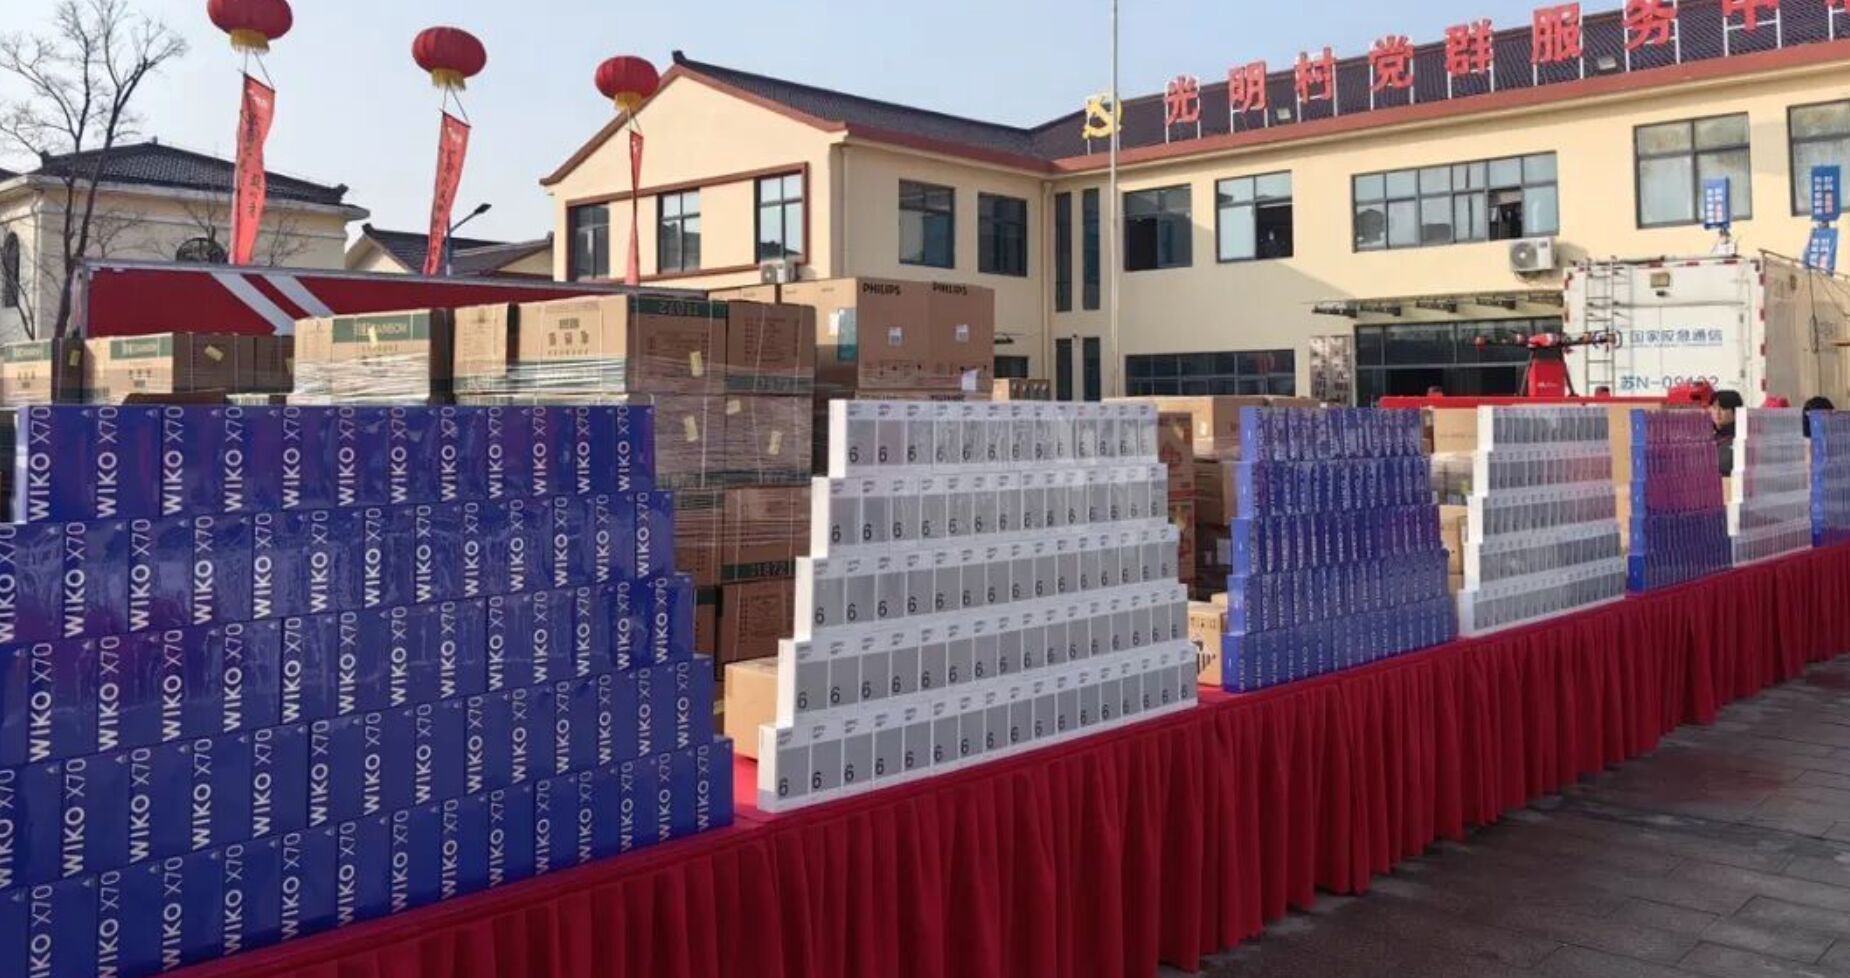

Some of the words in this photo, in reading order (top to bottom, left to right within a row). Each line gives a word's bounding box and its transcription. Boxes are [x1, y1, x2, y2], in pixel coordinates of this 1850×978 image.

[1165, 0, 1850, 124] 光明村党群服务中
[863, 283, 900, 295] PHILIPS
[933, 282, 967, 296] PHILIPS
[1630, 328, 1723, 342] 国家应急通信
[30, 407, 51, 444] X70
[98, 407, 118, 443] X70
[164, 407, 184, 442] X70
[226, 407, 244, 442] X70
[284, 407, 301, 442] X70
[339, 407, 356, 440] X70
[392, 407, 407, 439] X70
[442, 407, 456, 437] X70
[490, 407, 503, 438] X70
[534, 407, 547, 436] X70
[534, 443, 546, 496] WIKO
[849, 446, 859, 463] 6
[879, 446, 887, 463] 6
[908, 445, 916, 462] 6
[30, 453, 50, 521] WIKO
[97, 452, 117, 518] WIKO
[163, 450, 183, 515] WIKO
[225, 450, 243, 512] WIKO
[283, 448, 300, 509] WIKO
[338, 447, 355, 506] WIKO
[391, 446, 406, 504] WIKO
[442, 445, 456, 501] WIKO
[490, 445, 502, 499] WIKO
[312, 510, 328, 544] X70
[366, 508, 382, 541] X70
[416, 506, 432, 536] X70
[466, 503, 480, 533] X70
[511, 500, 525, 530] X70
[556, 497, 569, 526] X70
[922, 520, 930, 537] 6
[949, 518, 957, 534] 6
[975, 516, 983, 532] 6
[65, 522, 86, 560] X70
[131, 520, 151, 556] X70
[194, 517, 214, 553] X70
[254, 514, 272, 549] X70
[832, 525, 841, 543] 6
[864, 523, 871, 540] 6
[893, 522, 902, 538] 6
[365, 548, 380, 607] WIKO
[416, 544, 431, 602] WIKO
[466, 540, 478, 596] WIKO
[510, 538, 524, 592] WIKO
[555, 534, 568, 586] WIKO
[130, 564, 150, 631] WIKO
[194, 560, 213, 624] WIKO
[253, 556, 271, 618] WIKO
[311, 552, 328, 612] WIKO
[963, 590, 971, 606] 6
[988, 587, 995, 603] 6
[1012, 583, 1020, 599] 6
[1035, 580, 1043, 597] 6
[64, 569, 85, 637] WIKO
[442, 602, 456, 635] X70
[490, 596, 504, 630] X70
[534, 592, 548, 624] X70
[578, 587, 591, 619] X70
[815, 607, 824, 624] 6
[847, 603, 857, 621] 6
[878, 601, 887, 617] 6
[908, 596, 916, 612] 6
[936, 593, 944, 610] 6
[284, 618, 302, 655] X70
[340, 612, 357, 648] X70
[392, 606, 408, 641] X70
[100, 636, 120, 676] X70
[163, 630, 183, 669] X70
[224, 624, 244, 661] X70
[534, 629, 548, 684] WIKO
[577, 623, 590, 676] WIKO
[1024, 652, 1031, 668] 6
[1047, 648, 1055, 663] 6
[1069, 644, 1076, 659] 6
[30, 644, 52, 684] X70
[392, 648, 406, 706] WIKO
[442, 641, 456, 698] WIKO
[490, 635, 503, 691] WIKO
[922, 671, 931, 688] 6
[949, 666, 957, 683] 6
[975, 661, 984, 677] 6
[1000, 657, 1008, 673] 6
[224, 668, 243, 732] WIKO
[283, 660, 300, 724] WIKO
[340, 654, 356, 715] WIKO
[557, 682, 570, 713] X70
[600, 674, 612, 706] X70
[798, 692, 807, 709] 6
[831, 687, 840, 704] 6
[862, 681, 871, 699] 6
[892, 676, 901, 693] 6
[99, 684, 120, 751] WIKO
[162, 676, 182, 742] WIKO
[417, 704, 432, 738] X70
[468, 696, 483, 730] X70
[513, 688, 528, 721] X70
[1081, 710, 1087, 725] 6
[30, 692, 52, 762] WIKO
[310, 720, 329, 757] X70
[366, 712, 382, 748] X70
[599, 712, 611, 766] WIKO
[987, 732, 994, 749] 6
[1011, 726, 1019, 743] 6
[1035, 720, 1043, 737] 6
[1058, 715, 1065, 731] 6
[192, 739, 212, 776] X70
[254, 729, 272, 766] X70
[468, 736, 482, 793] WIKO
[512, 728, 526, 783] WIKO
[556, 720, 570, 774] WIKO
[905, 751, 914, 768] 6
[934, 745, 943, 762] 6
[961, 738, 969, 755] 6
[64, 759, 86, 799] X70
[130, 748, 151, 786] X70
[416, 746, 432, 804] WIKO
[812, 772, 822, 789] 6
[845, 764, 854, 782] 6
[876, 758, 884, 775] 6
[310, 764, 328, 827] WIKO
[365, 754, 381, 816] WIKO
[538, 780, 552, 812] X70
[580, 771, 593, 802] X70
[779, 778, 788, 796] 6
[192, 784, 212, 850] WIKO
[254, 774, 272, 838] WIKO
[443, 800, 459, 833] X70
[491, 790, 506, 822] X70
[64, 806, 86, 878] WIKO
[130, 794, 150, 862] WIKO
[340, 822, 357, 859] X70
[393, 810, 409, 845] X70
[580, 808, 592, 864] WIKO
[226, 844, 244, 883] X70
[283, 833, 301, 870] X70
[490, 829, 504, 887] WIKO
[537, 819, 550, 875] WIKO
[164, 857, 184, 896] X70
[392, 852, 408, 913] WIKO
[442, 840, 458, 899] WIKO
[100, 871, 121, 911] X70
[282, 876, 300, 940] WIKO
[339, 865, 356, 928] WIKO
[163, 903, 182, 970] WIKO
[226, 890, 243, 956] WIKO
[99, 919, 120, 978] WIKO
